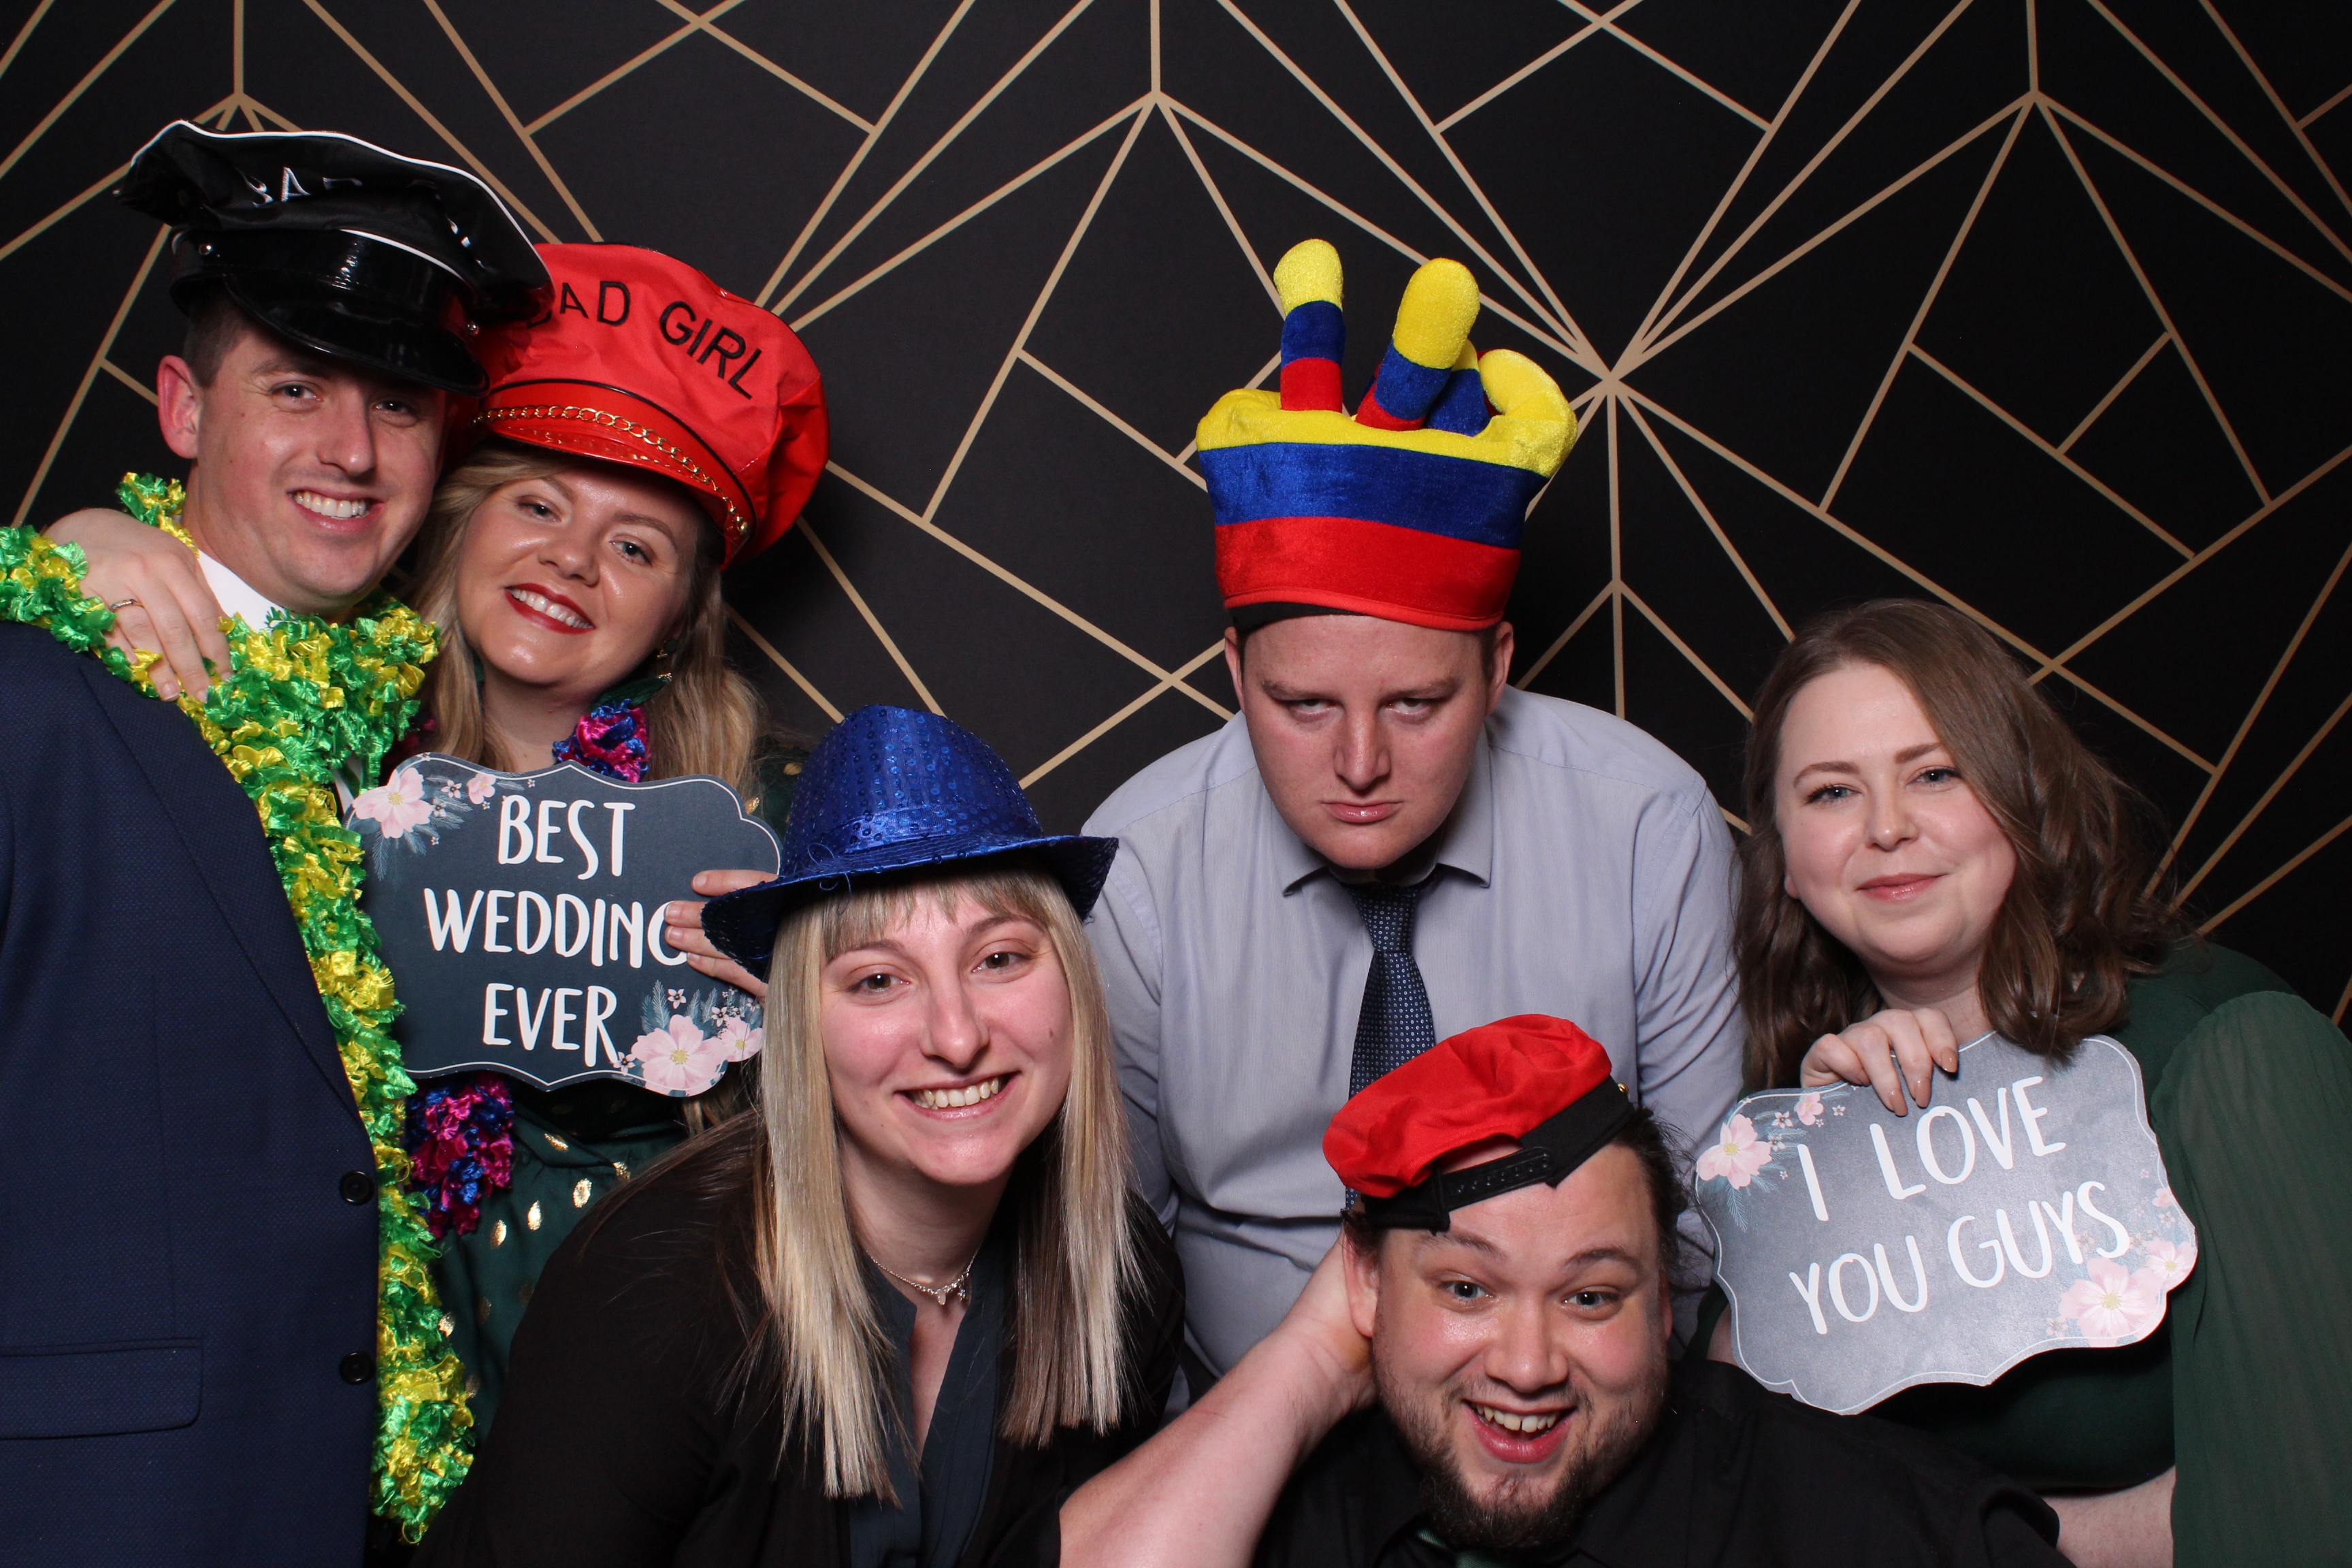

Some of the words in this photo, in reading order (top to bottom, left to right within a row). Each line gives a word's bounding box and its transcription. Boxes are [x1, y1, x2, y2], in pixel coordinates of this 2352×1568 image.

[525, 280, 631, 330] AD
[659, 300, 763, 400] GIRL
[497, 794, 636, 881] BEST
[482, 982, 618, 1067] EVER
[1797, 1143, 1829, 1222] I
[1869, 1075, 2067, 1200] LOVE
[1788, 1235, 1928, 1335] YOU
[1946, 1181, 2130, 1289] GUYS
